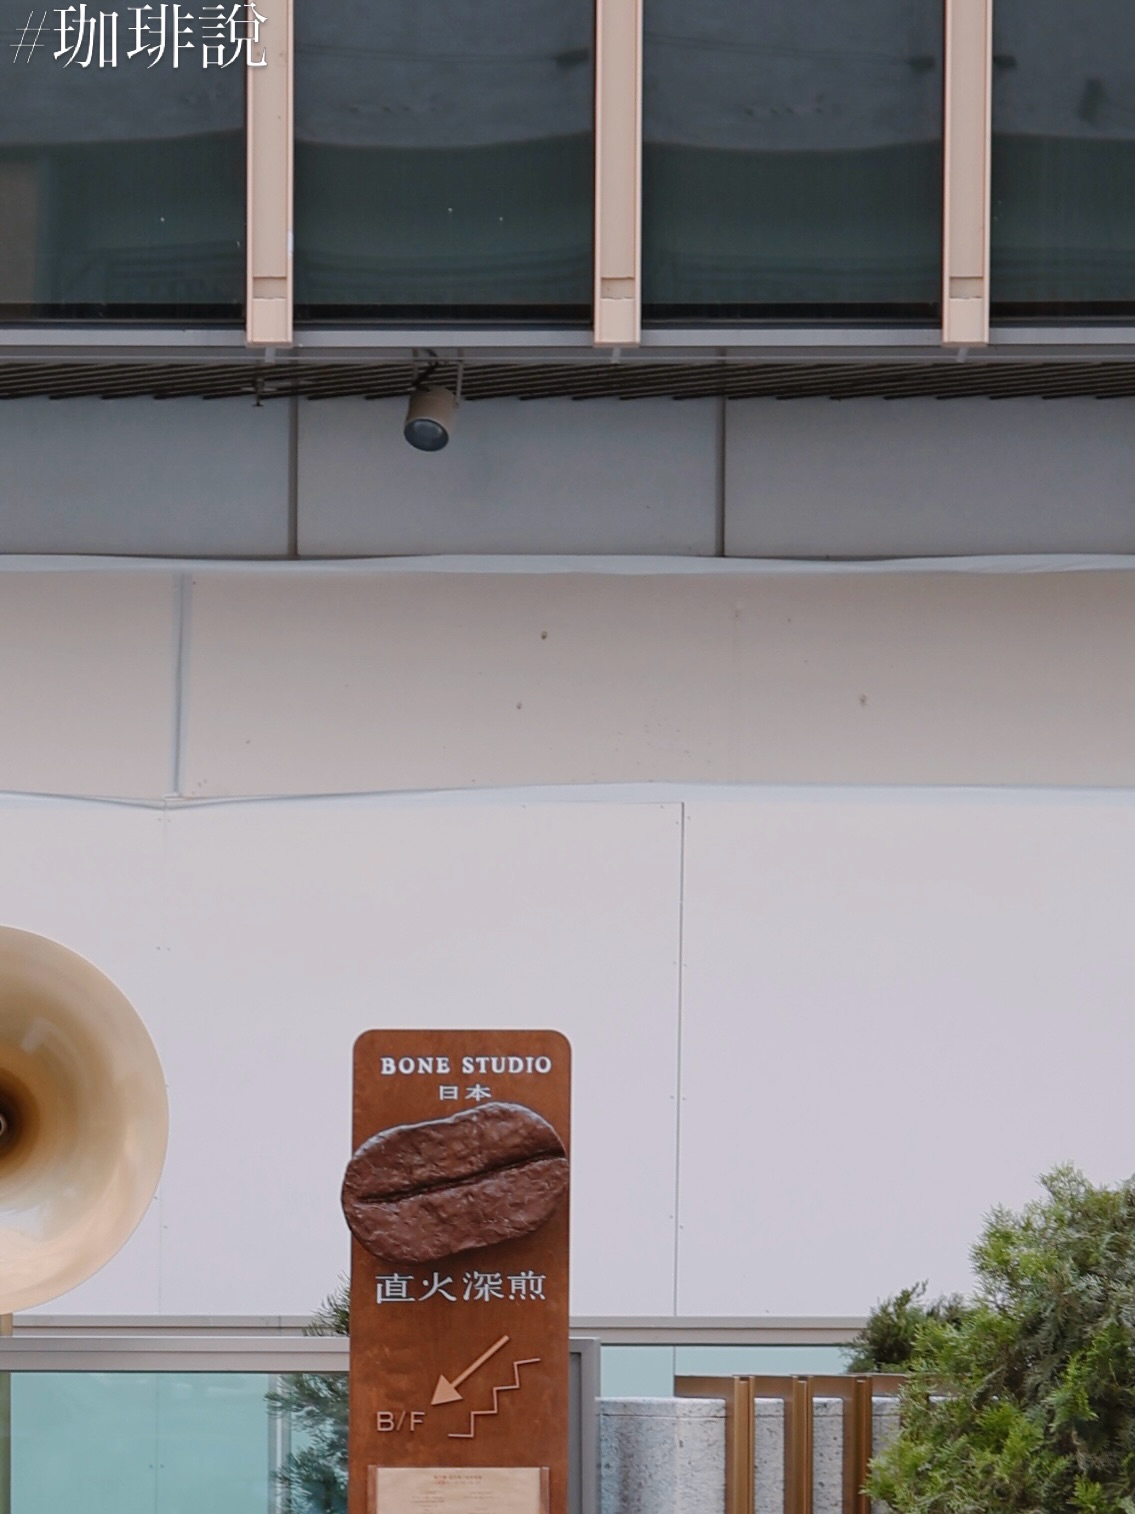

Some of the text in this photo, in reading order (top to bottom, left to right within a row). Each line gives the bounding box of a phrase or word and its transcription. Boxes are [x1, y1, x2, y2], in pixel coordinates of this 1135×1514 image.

[380, 1056, 552, 1075] BONE STUDIO
[439, 1084, 492, 1101] 日本
[375, 1270, 547, 1304] 直火深煎
[376, 1410, 426, 1432] B/F
